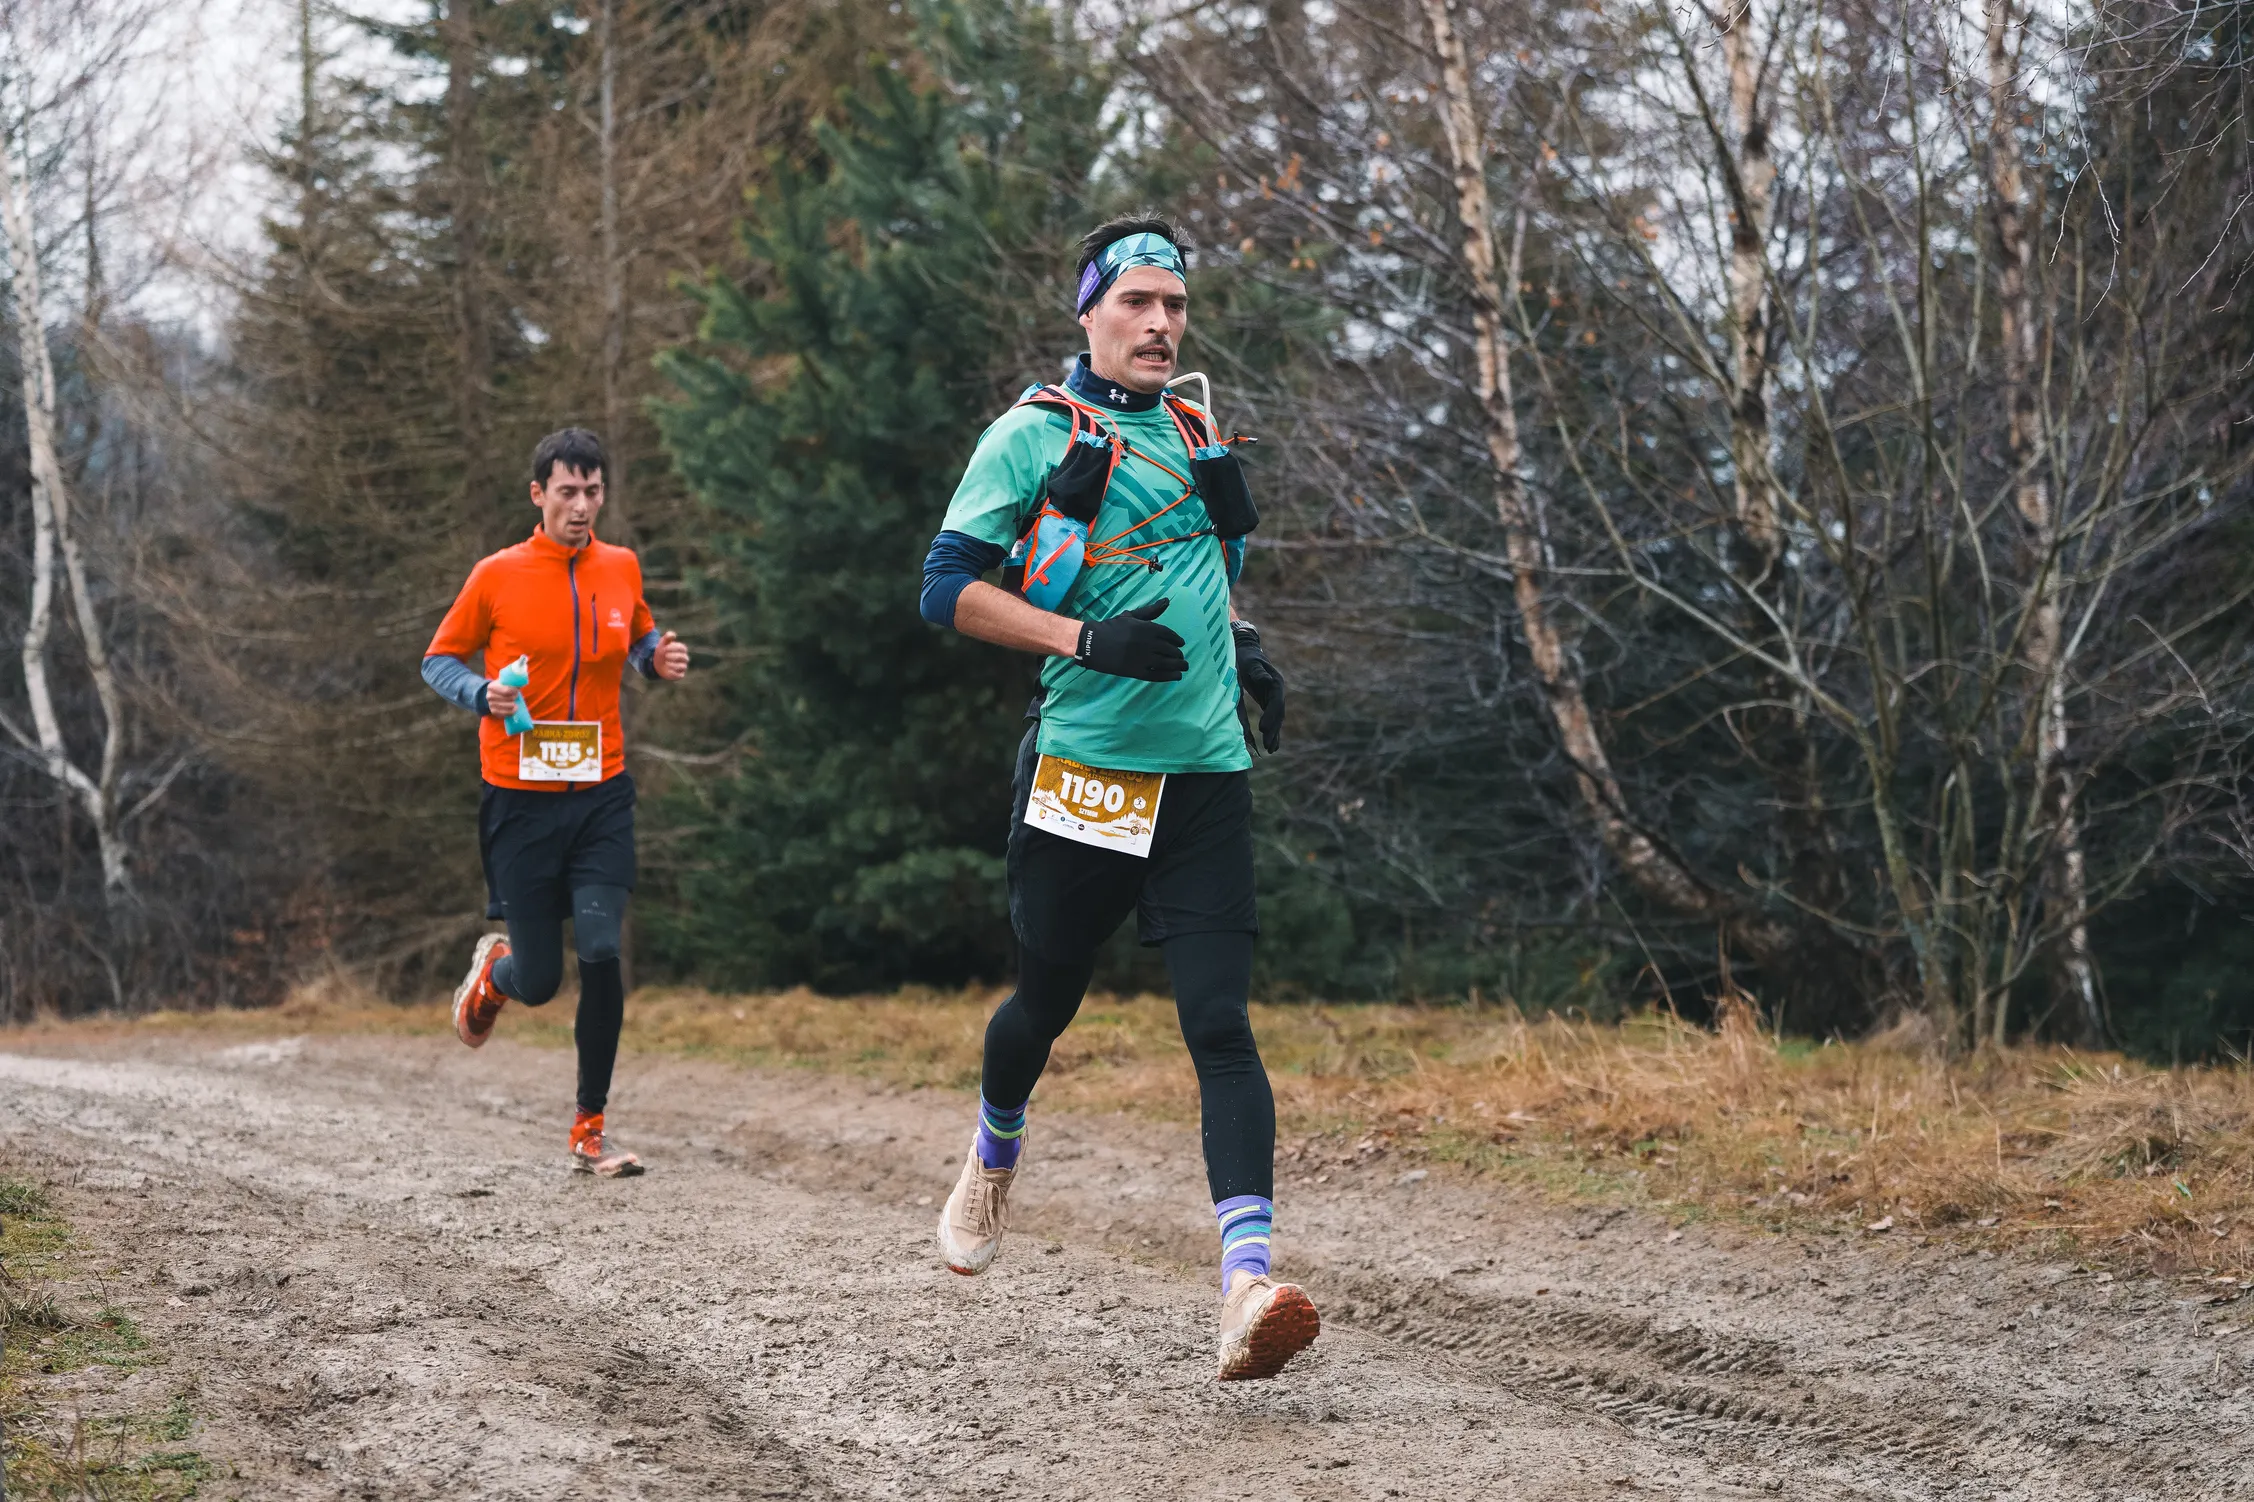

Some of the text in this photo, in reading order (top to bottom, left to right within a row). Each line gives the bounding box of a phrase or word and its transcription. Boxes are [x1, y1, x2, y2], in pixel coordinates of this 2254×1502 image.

[1085, 629, 1094, 657] KIPRUN
[539, 741, 582, 763] 1135
[1060, 770, 1125, 813] 1190
